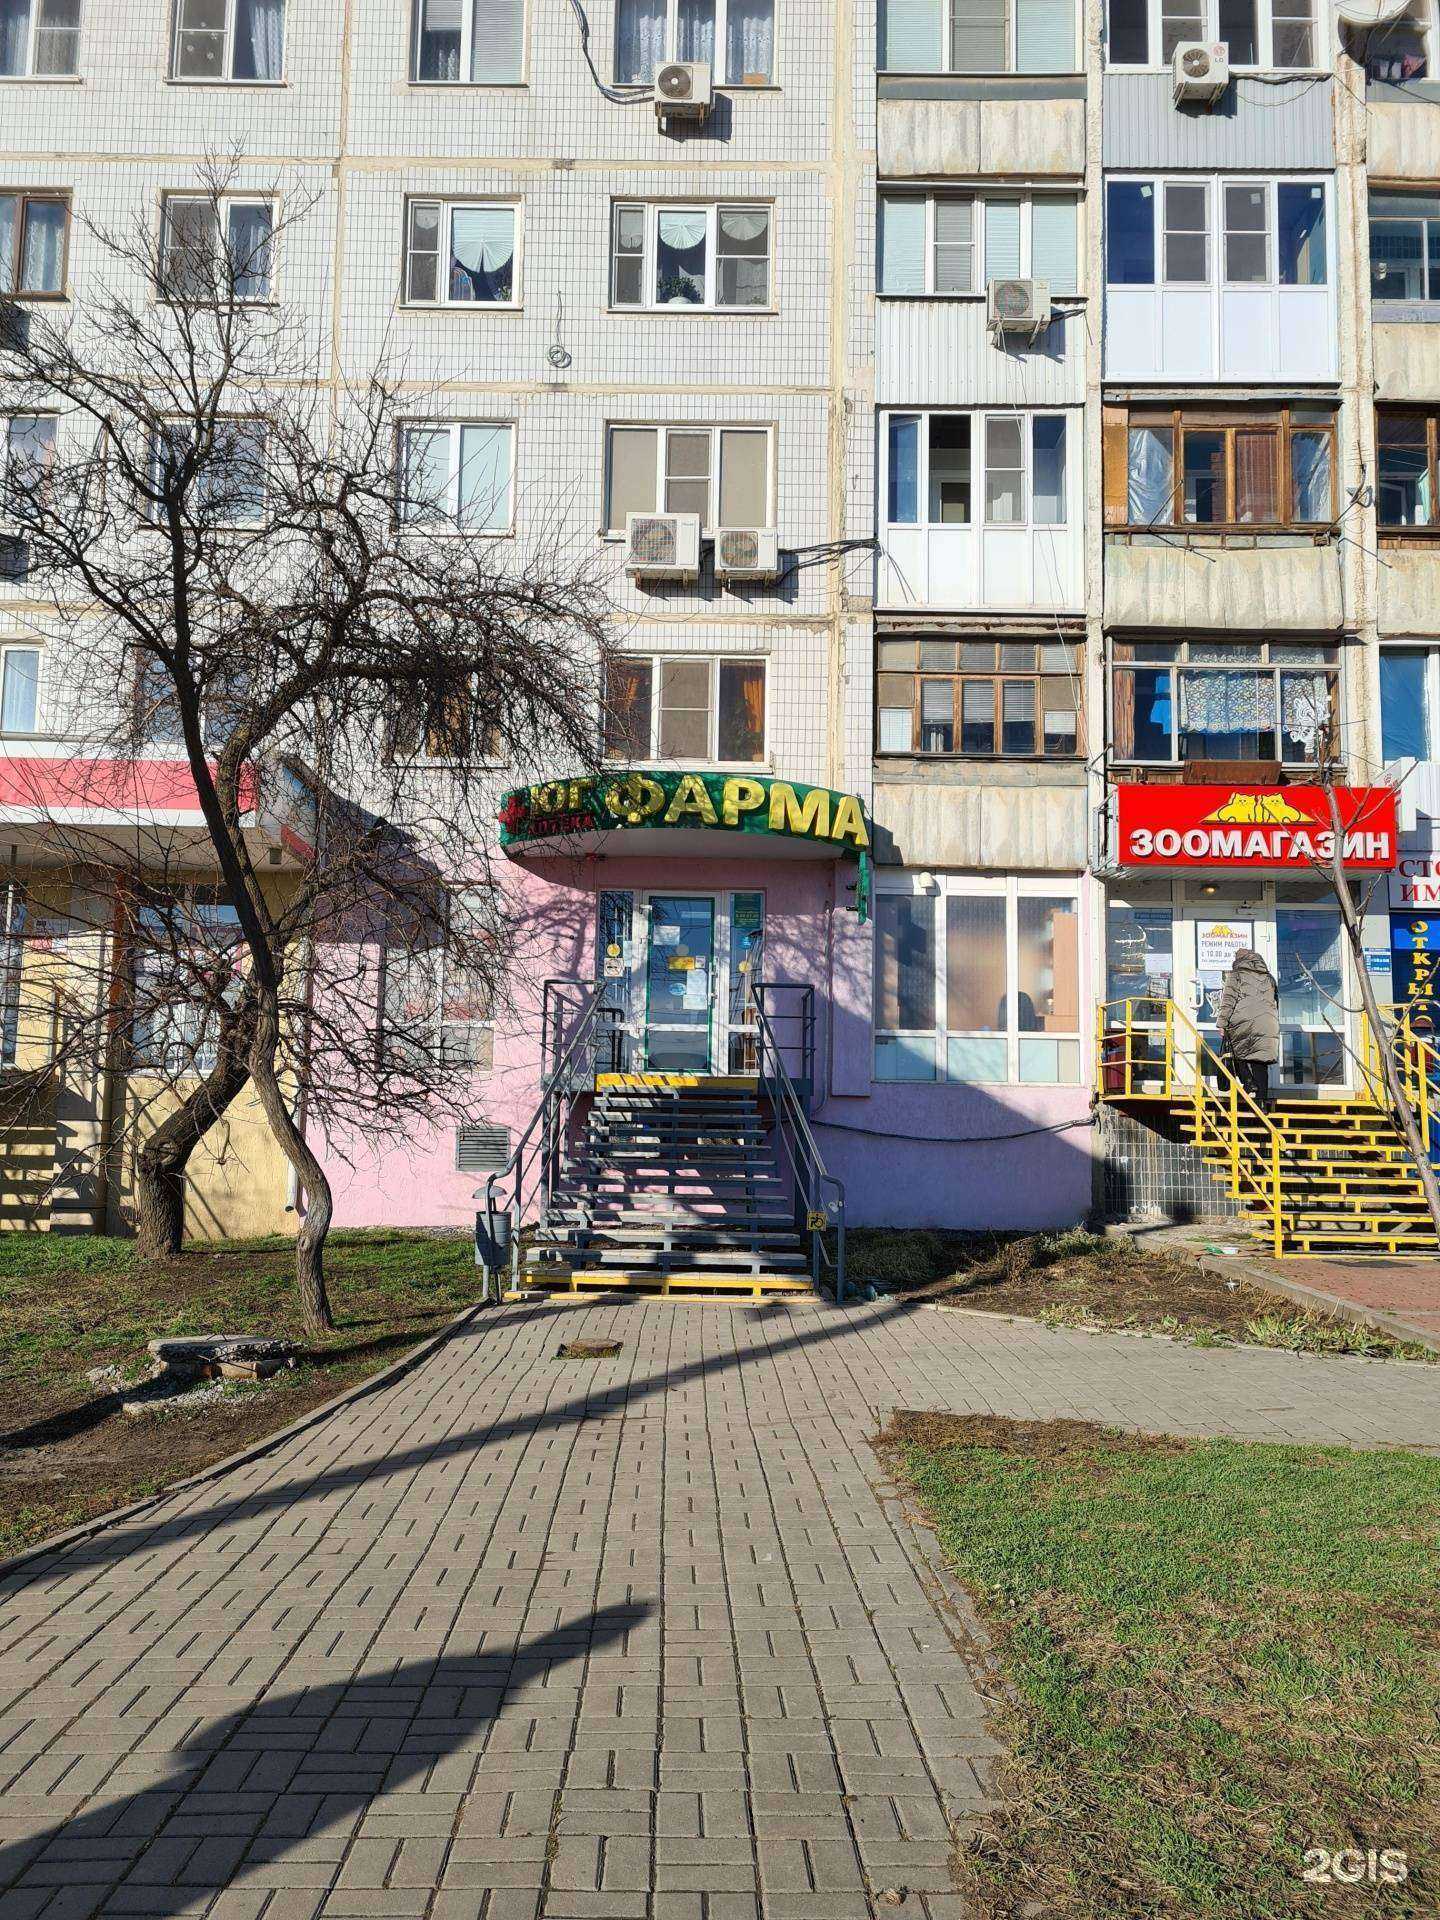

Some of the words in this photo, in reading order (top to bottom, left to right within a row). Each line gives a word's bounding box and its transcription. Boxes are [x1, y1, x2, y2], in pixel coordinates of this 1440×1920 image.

[530, 778, 595, 813] ЮГ
[604, 772, 869, 846] ФАРМА
[1129, 829, 1389, 860] ЗООМАГАЗИН
[1399, 859, 1440, 878] СТ
